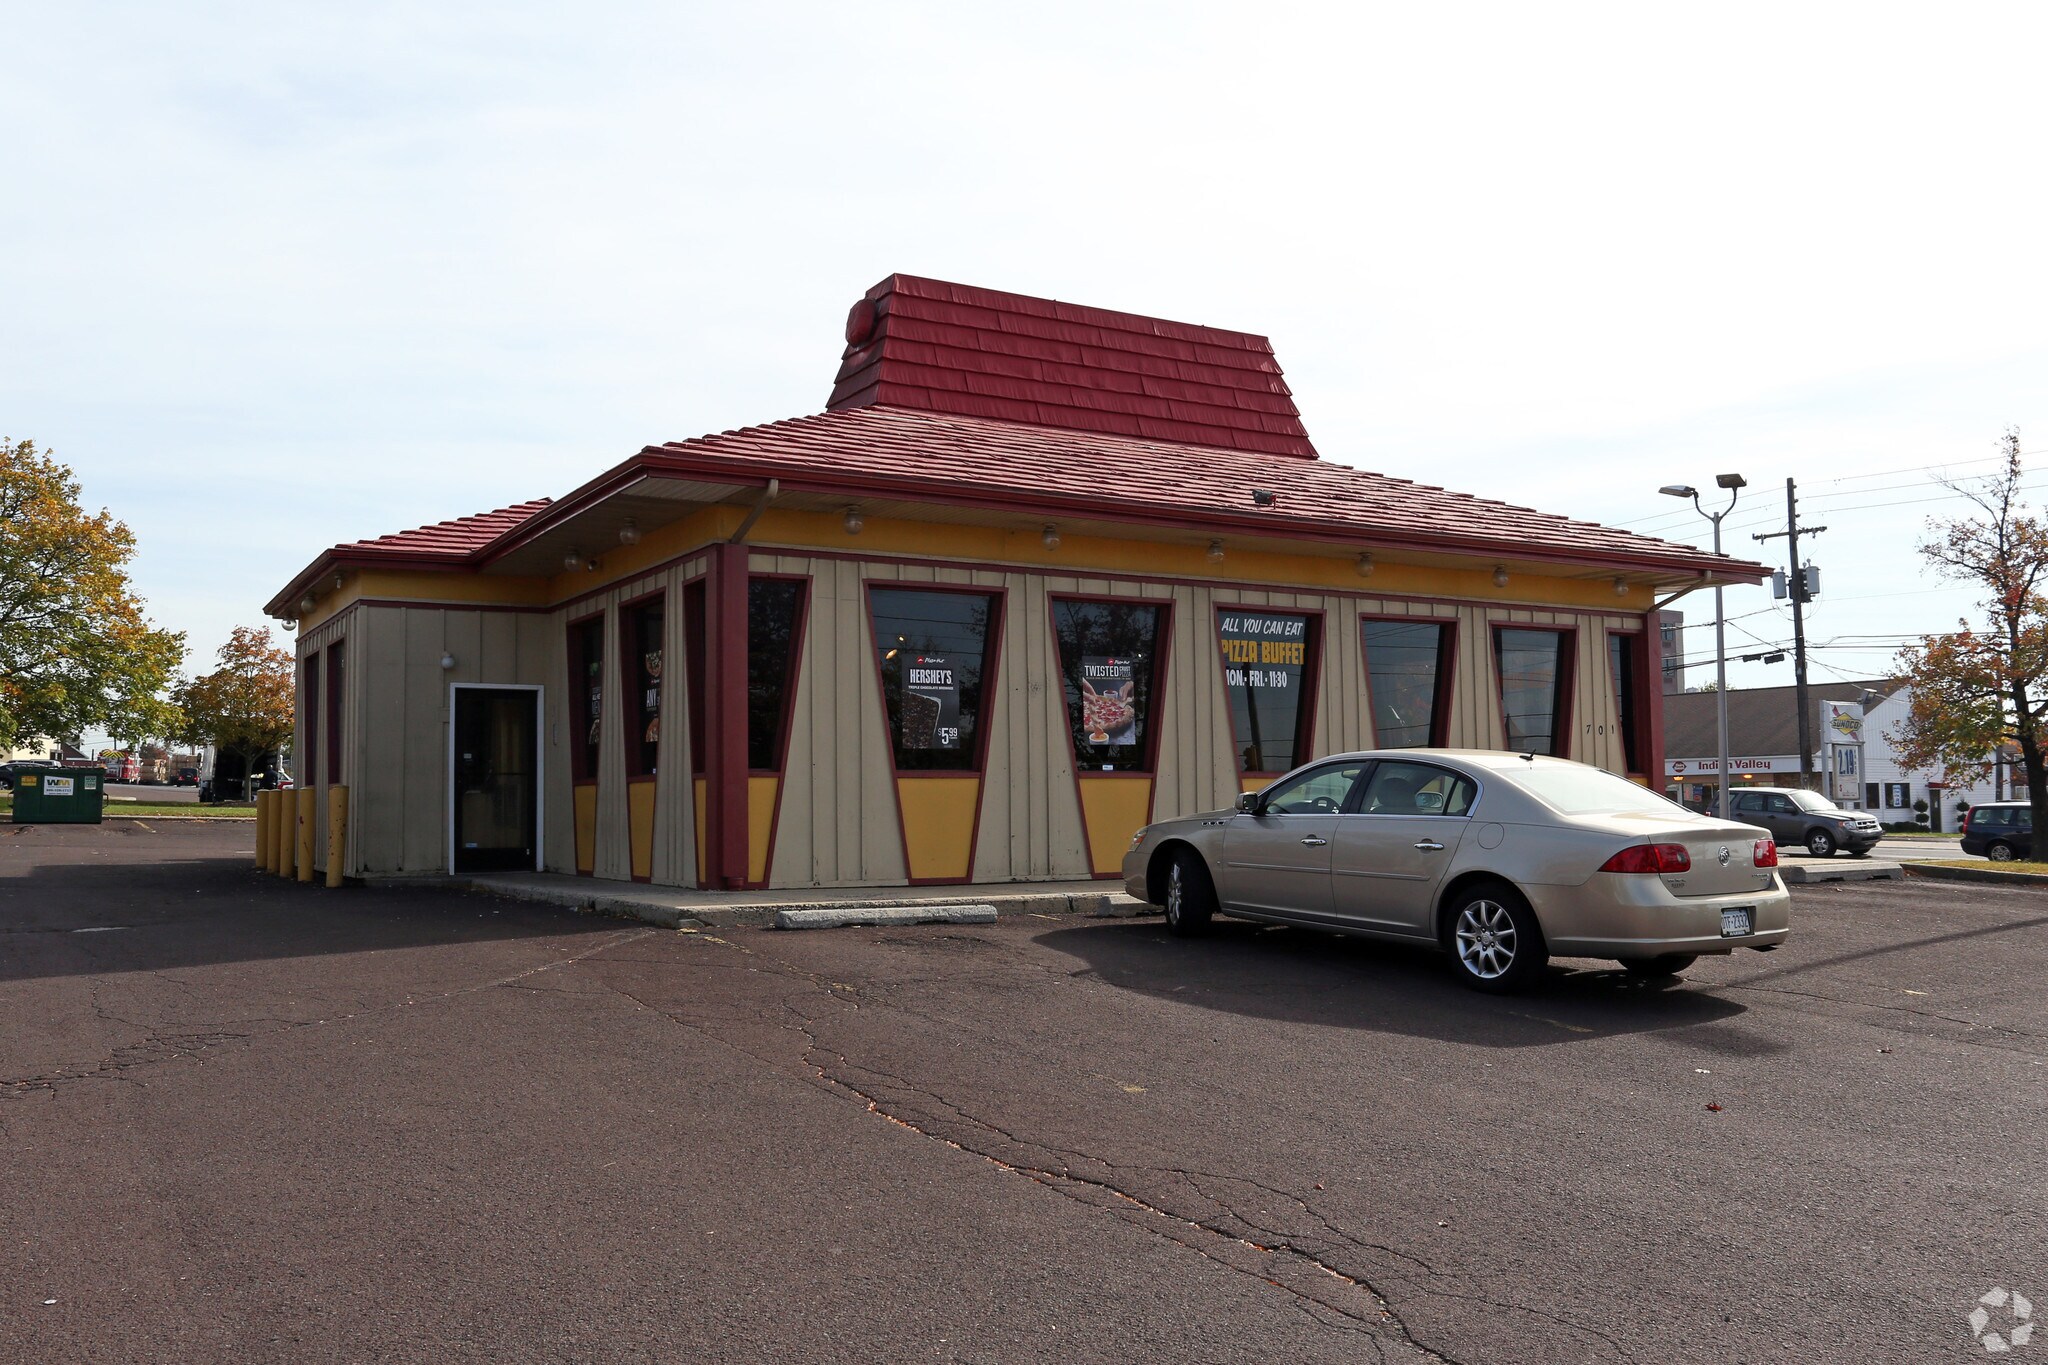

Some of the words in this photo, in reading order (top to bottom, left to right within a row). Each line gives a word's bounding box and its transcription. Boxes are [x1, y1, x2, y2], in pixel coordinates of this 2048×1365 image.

[1221, 618, 1239, 632] ALL
[1243, 618, 1263, 634] YOU
[1263, 620, 1285, 635] CAN
[1285, 621, 1304, 636] EAT
[1221, 639, 1258, 663] PIZZA
[1261, 641, 1305, 665] BUFFET
[909, 668, 953, 685] HERSHEY'S
[1084, 665, 1119, 677] TWISTED
[1586, 724, 1615, 735] 701
[1832, 719, 1860, 730] SUNOCO
[1698, 760, 1733, 770] Indin
[1735, 759, 1771, 770] Valley
